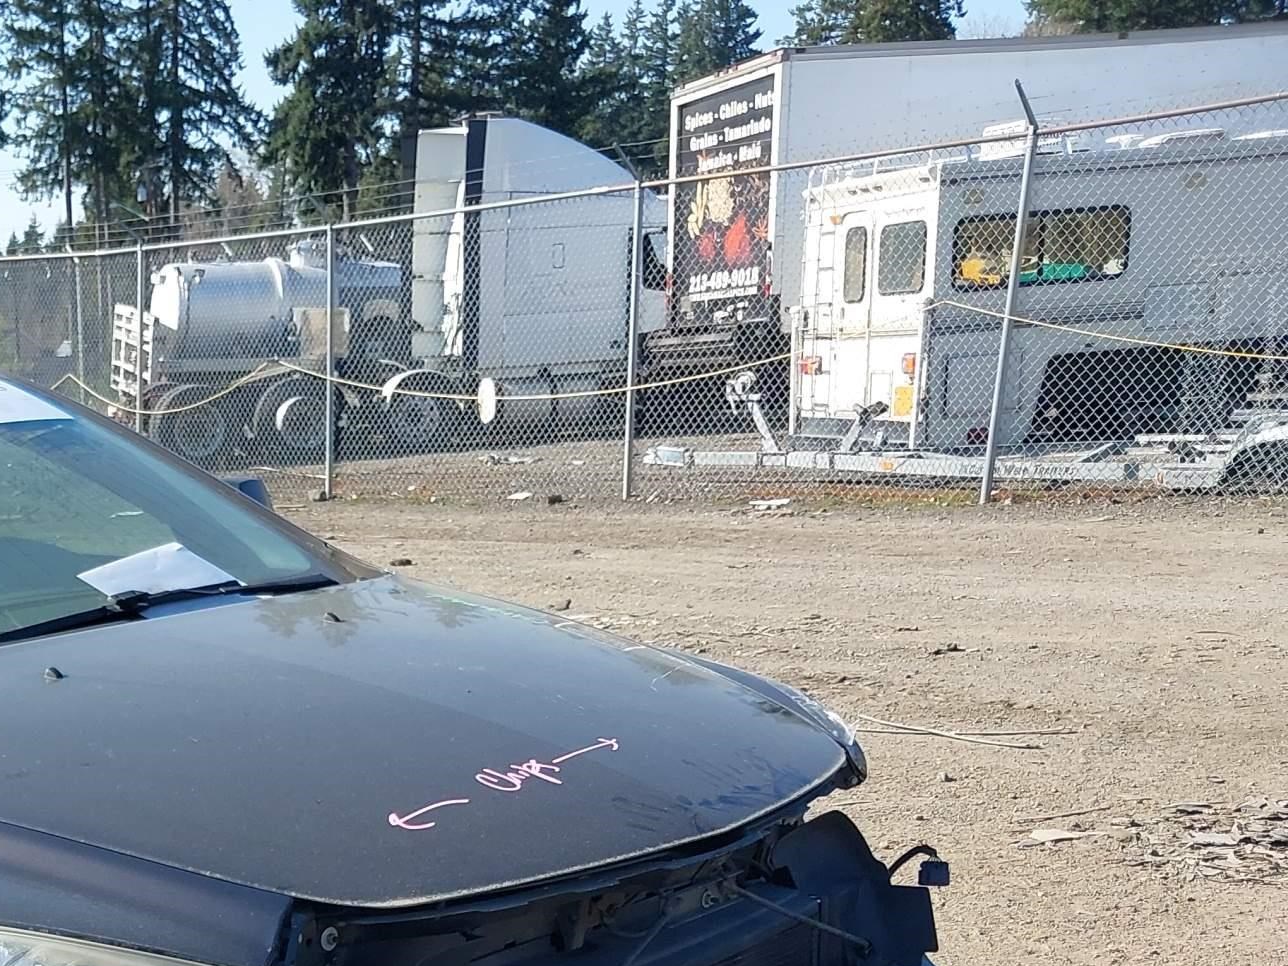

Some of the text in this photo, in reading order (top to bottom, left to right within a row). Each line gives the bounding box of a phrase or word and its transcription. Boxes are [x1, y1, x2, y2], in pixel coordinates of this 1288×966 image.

[684, 112, 713, 132] Spices
[719, 101, 748, 120] Chiles
[690, 132, 718, 151] Grains
